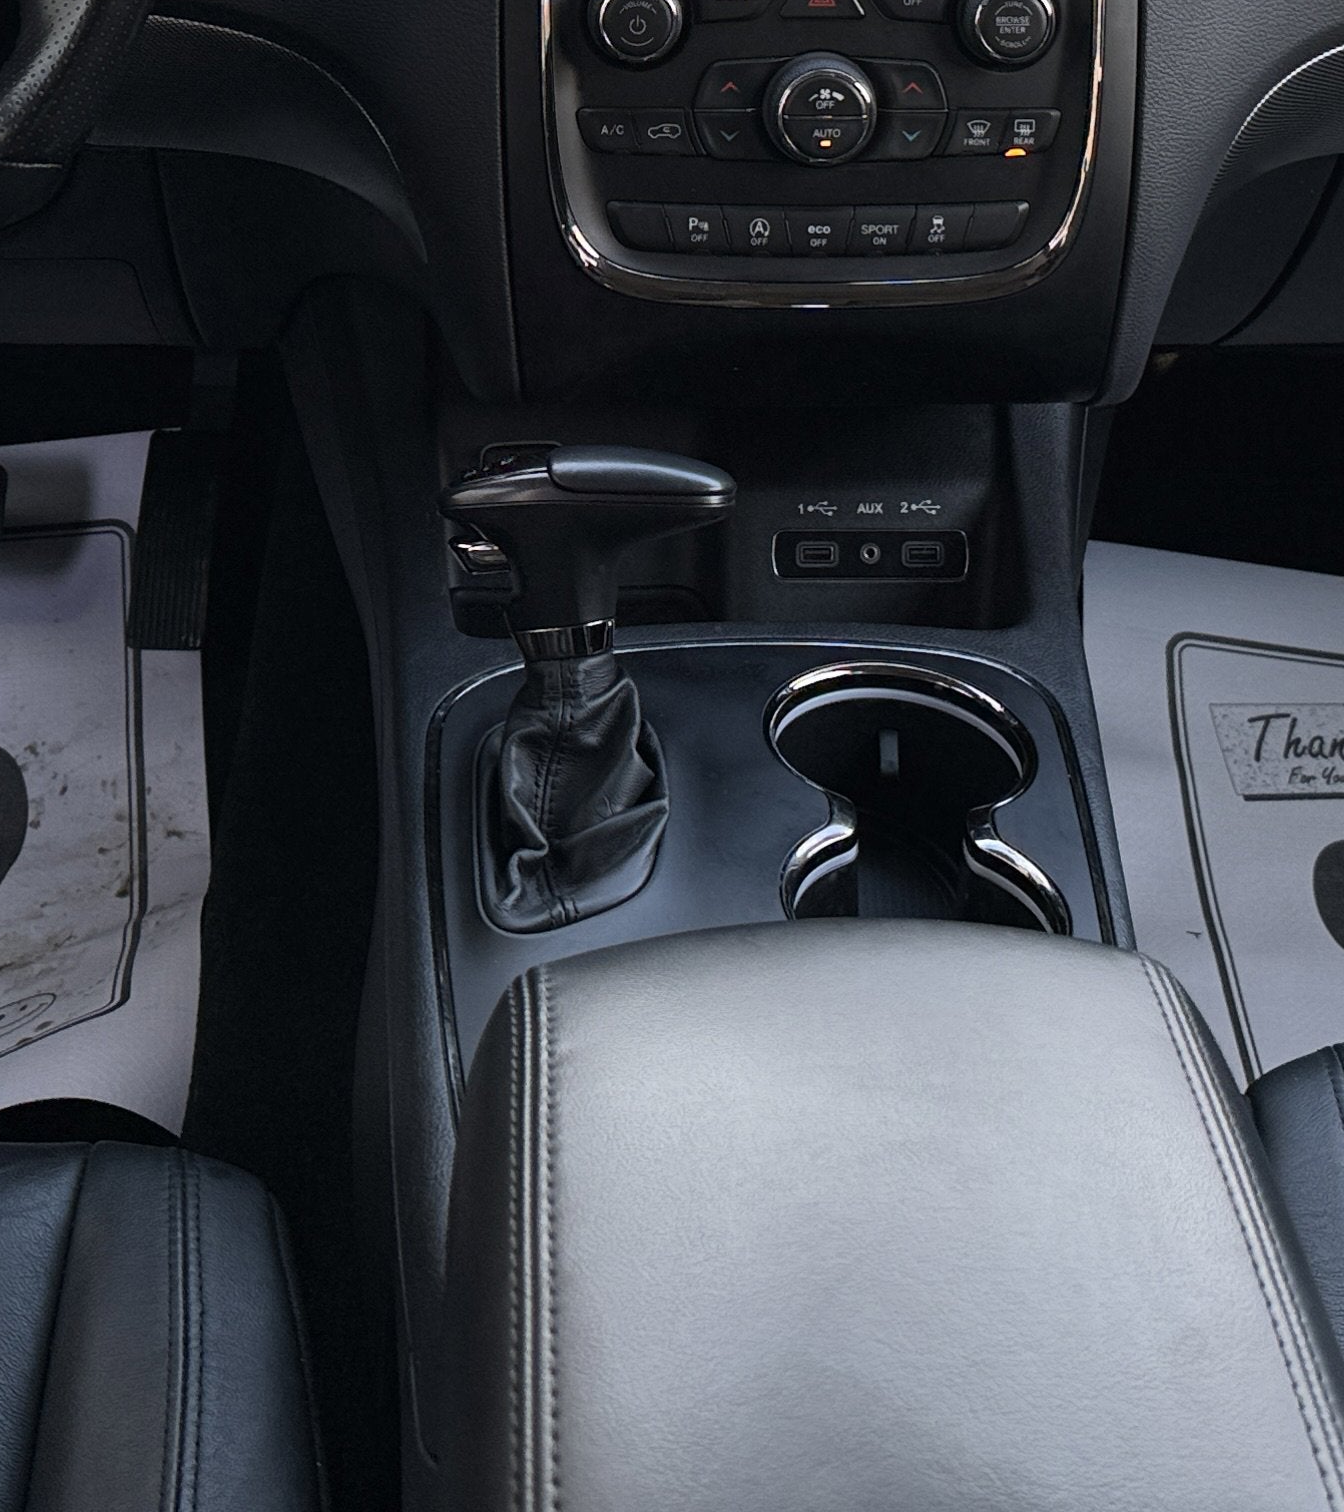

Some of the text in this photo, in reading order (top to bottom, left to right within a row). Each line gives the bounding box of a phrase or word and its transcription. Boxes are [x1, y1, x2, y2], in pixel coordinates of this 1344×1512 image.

[623, 0, 653, 10] VOLUME
[1004, 1, 1024, 9] TUNE
[996, 16, 1031, 25] BROWSE
[999, 26, 1027, 34] ENTER
[816, 100, 836, 110] OFF
[600, 124, 625, 136] A/C
[812, 127, 842, 139] AUTO
[963, 138, 991, 147] FRONT
[1013, 136, 1035, 145] REAR
[807, 225, 831, 234] eco
[861, 224, 899, 235] SPORT
[691, 233, 708, 243] OFF
[750, 237, 768, 246] OFF
[810, 238, 827, 247] OFF
[872, 236, 887, 246] ON
[928, 234, 945, 243] OFF
[798, 503, 804, 514] 1
[857, 503, 884, 514] AUX
[900, 502, 909, 514] 2
[1287, 766, 1316, 785] For
